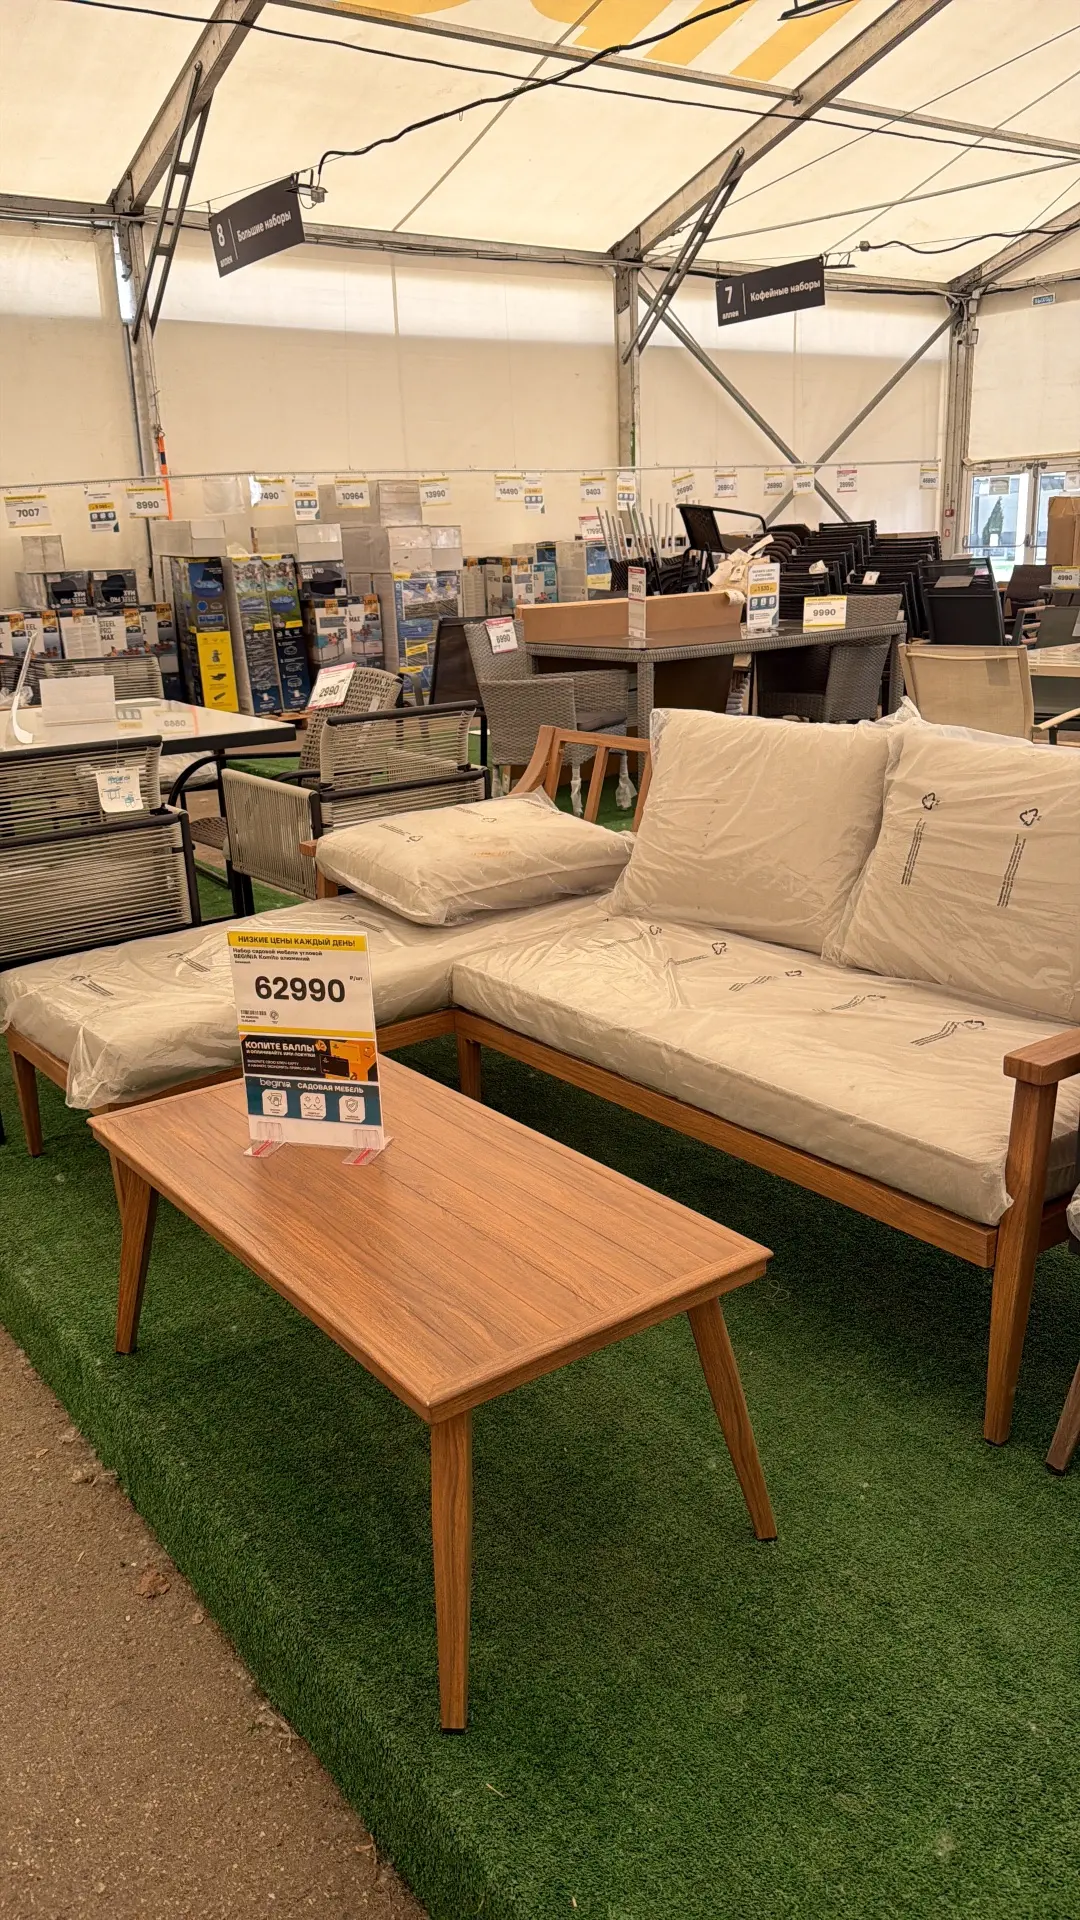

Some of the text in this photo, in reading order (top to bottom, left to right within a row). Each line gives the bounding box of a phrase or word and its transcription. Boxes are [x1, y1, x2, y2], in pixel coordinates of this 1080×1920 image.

[236, 211, 291, 242] Большие наборы
[217, 224, 225, 246] 8
[725, 286, 732, 304] 7
[750, 280, 820, 302] Кофейные наборы
[425, 490, 445, 498] 13990
[136, 501, 159, 509] 8990
[16, 508, 40, 517] 7007
[319, 685, 339, 697] 2990
[294, 938, 330, 946] КАЖДЫЙ
[255, 976, 345, 1003] 62990
[245, 1041, 315, 1052] КОПИТЕ БАЛЛЫ
[297, 1082, 333, 1091] САДОВАЯ
[334, 1085, 364, 1093] МЕБЕЛЬ
